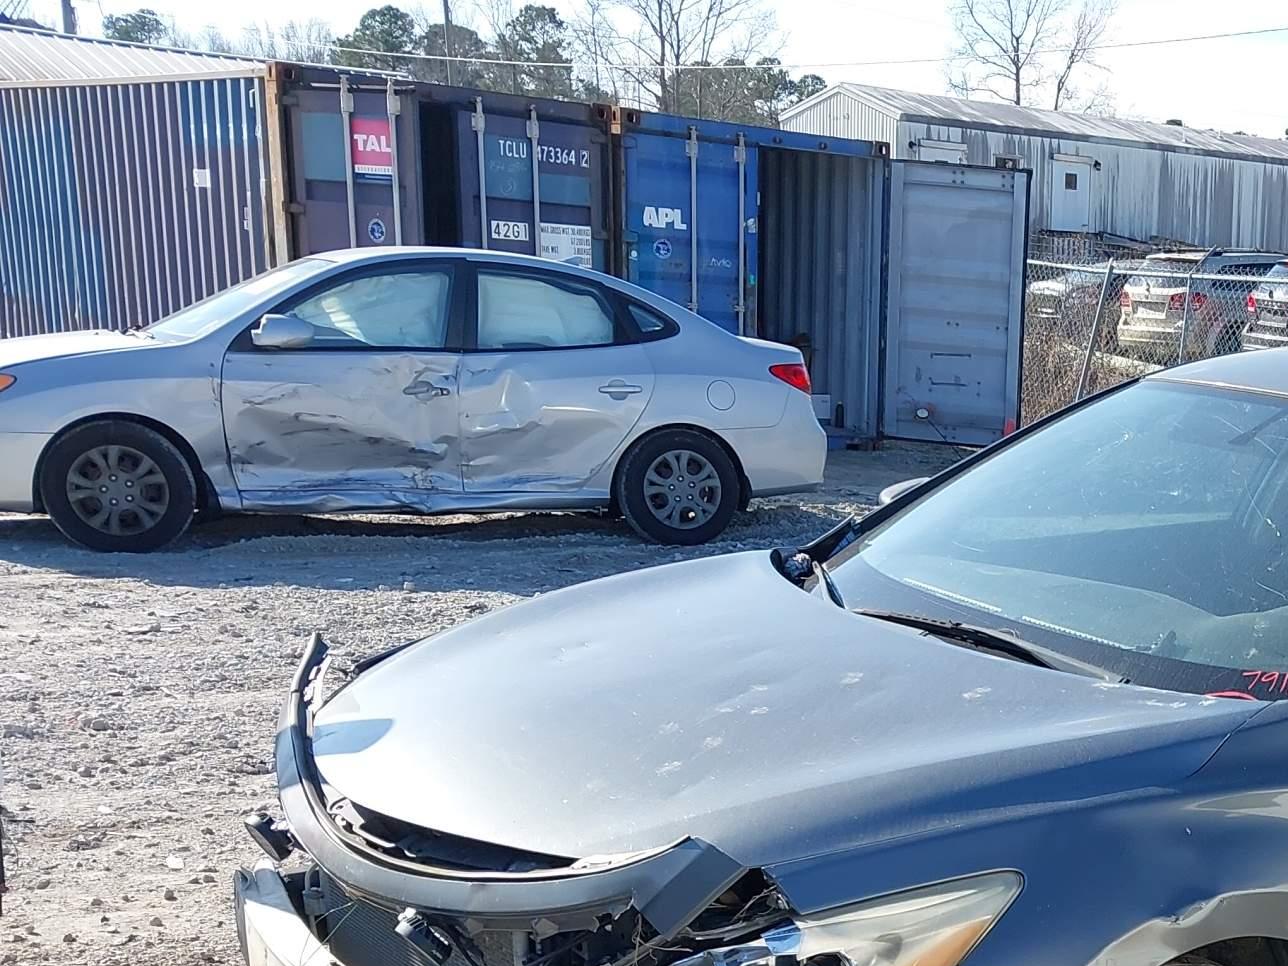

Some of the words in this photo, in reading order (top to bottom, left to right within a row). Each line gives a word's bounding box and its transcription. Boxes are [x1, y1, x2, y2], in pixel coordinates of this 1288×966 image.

[353, 134, 391, 152] TAL
[498, 140, 527, 158] TCLU
[581, 151, 588, 168] 2
[643, 206, 687, 230] APL
[493, 222, 528, 239] 42G1
